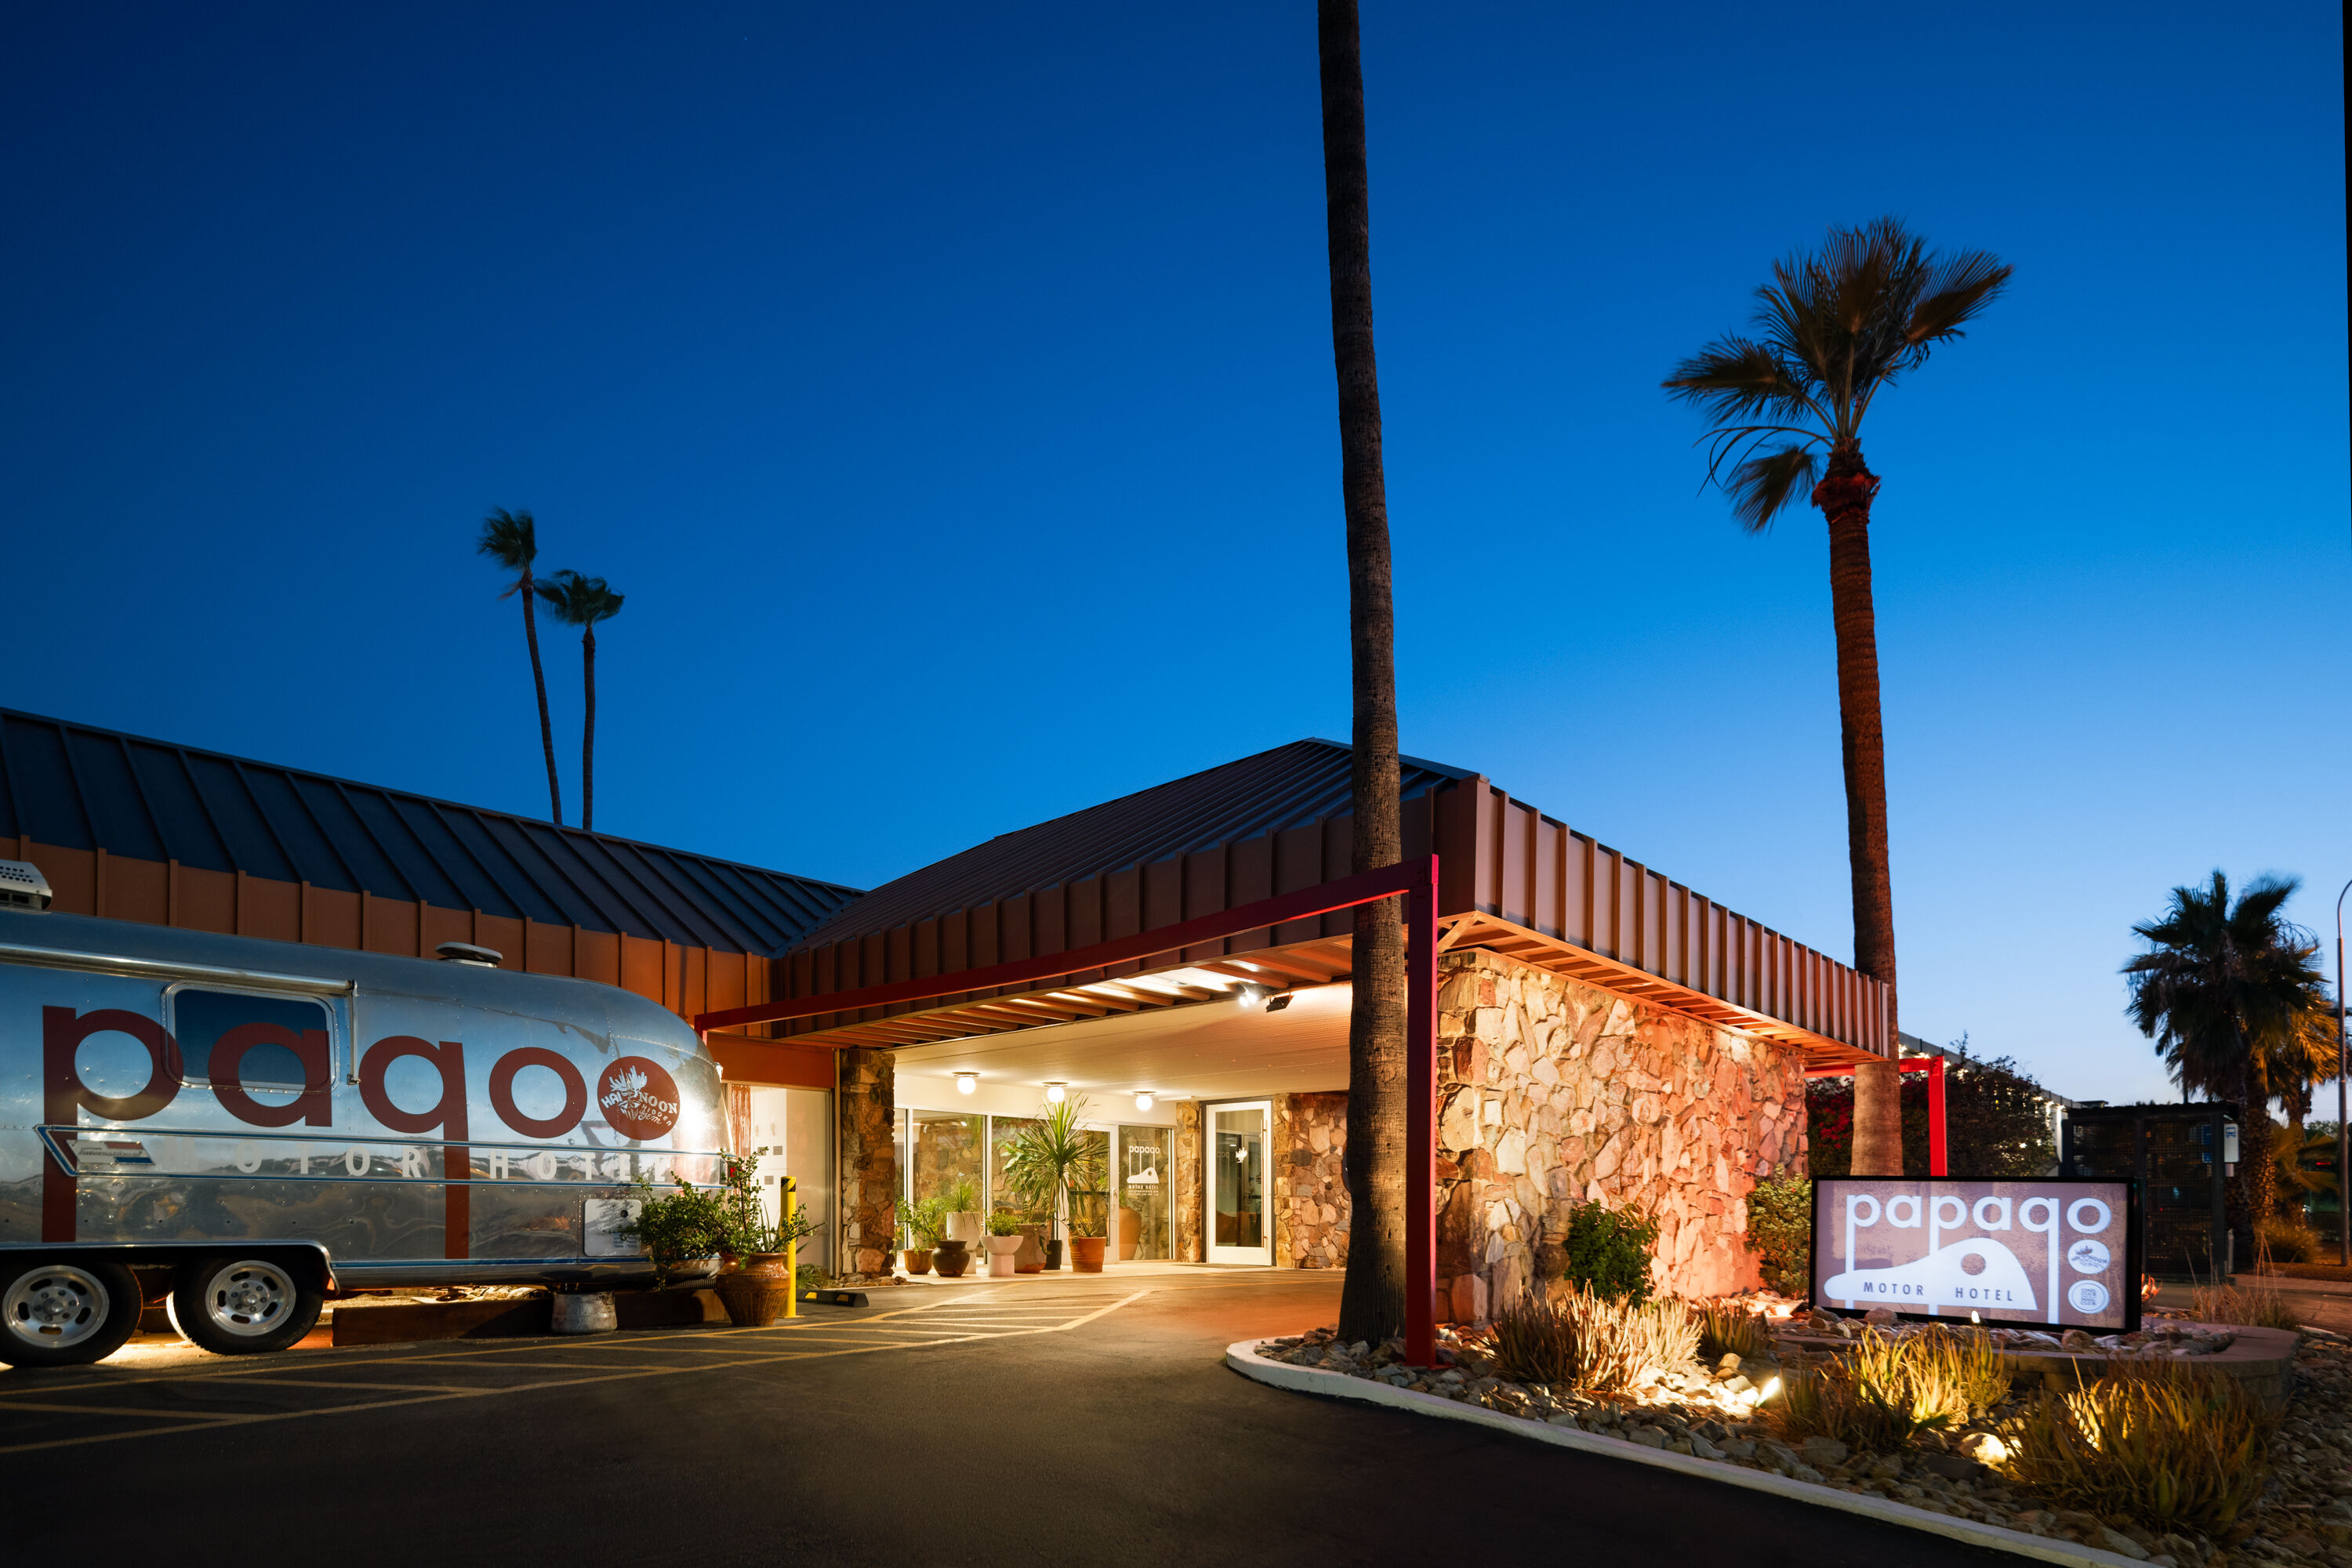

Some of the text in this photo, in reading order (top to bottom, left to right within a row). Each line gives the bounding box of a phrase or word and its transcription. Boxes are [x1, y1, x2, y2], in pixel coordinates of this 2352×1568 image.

[601, 1091, 677, 1114] HAI NOON
[489, 1149, 666, 1181] HOTEL
[1864, 1282, 2013, 1301] MOTOR HOTEL
